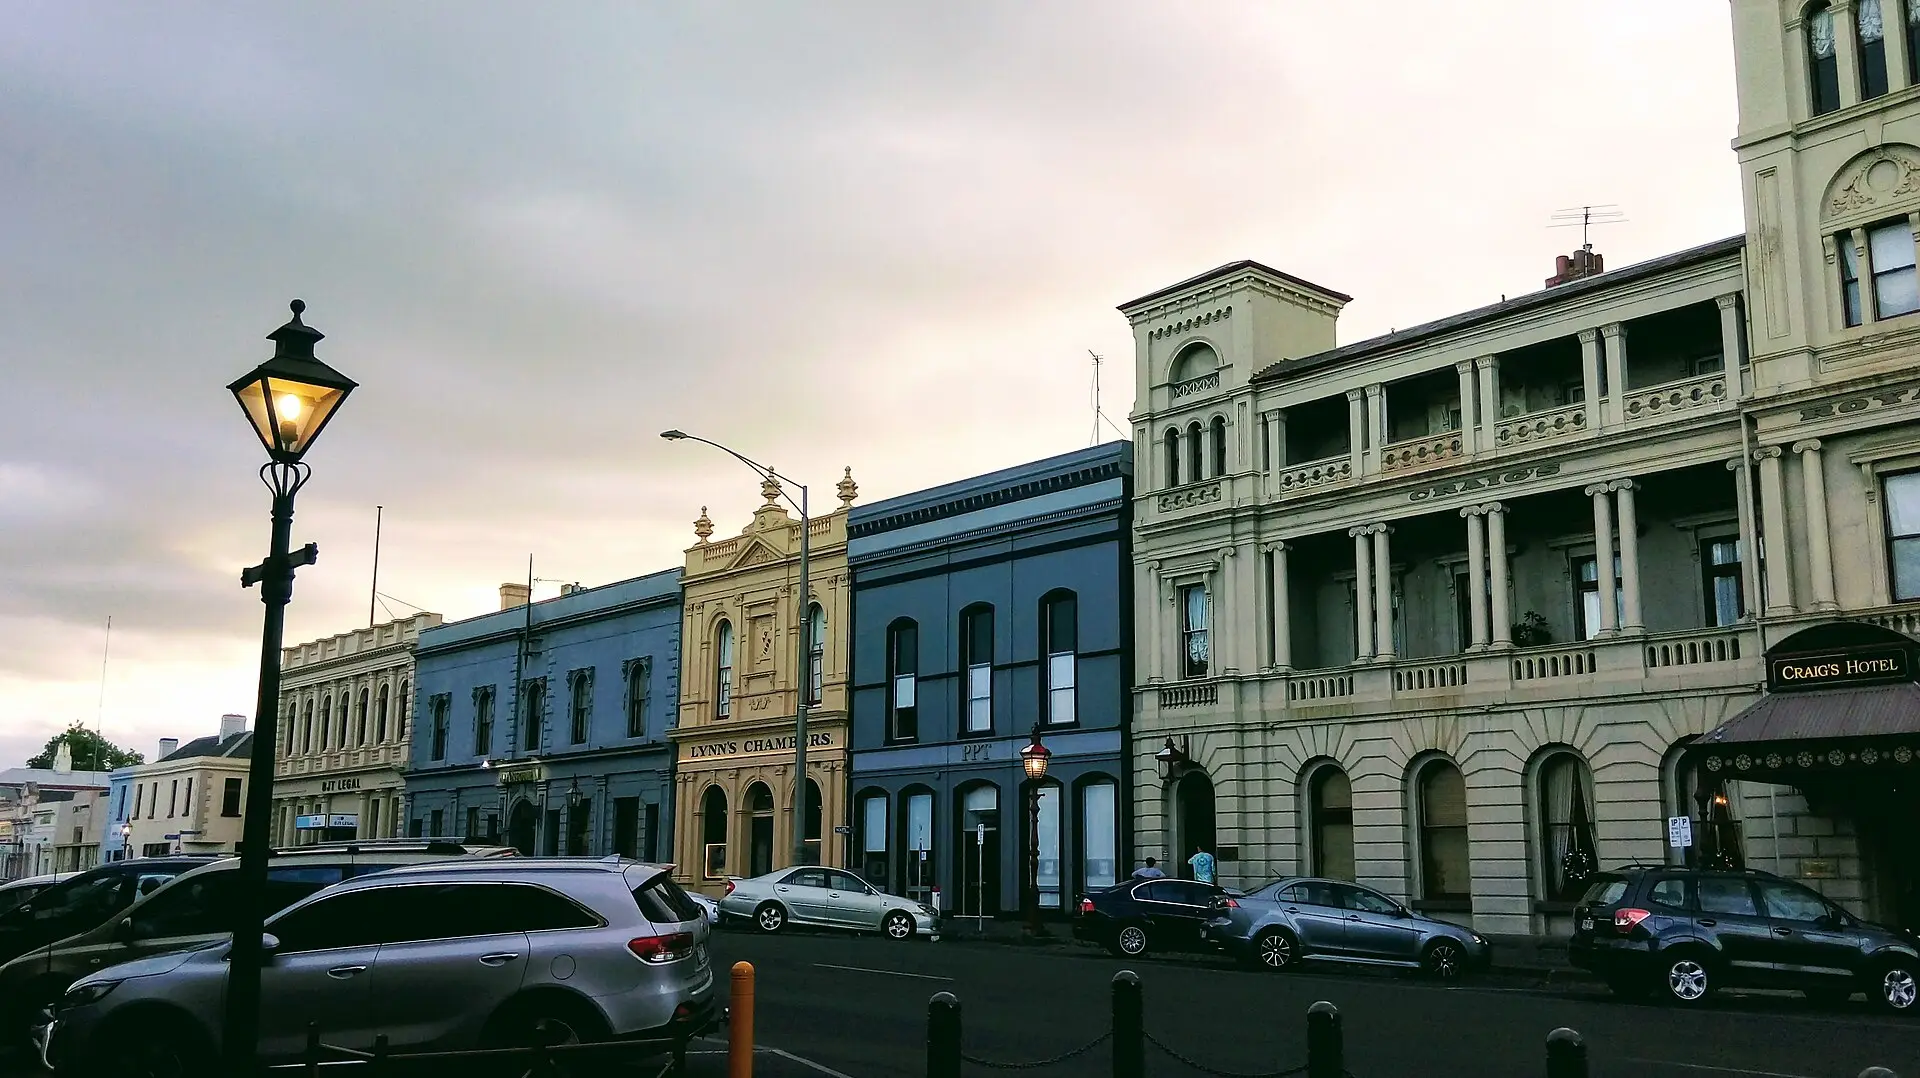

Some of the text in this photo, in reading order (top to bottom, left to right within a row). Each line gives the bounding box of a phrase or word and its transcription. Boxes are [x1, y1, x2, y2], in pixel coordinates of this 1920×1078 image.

[1800, 386, 1920, 421] ROY
[691, 732, 834, 757] LYNN'S CHAMBRS.
[962, 743, 992, 761] PPT
[322, 779, 360, 792] BJT LEGAL
